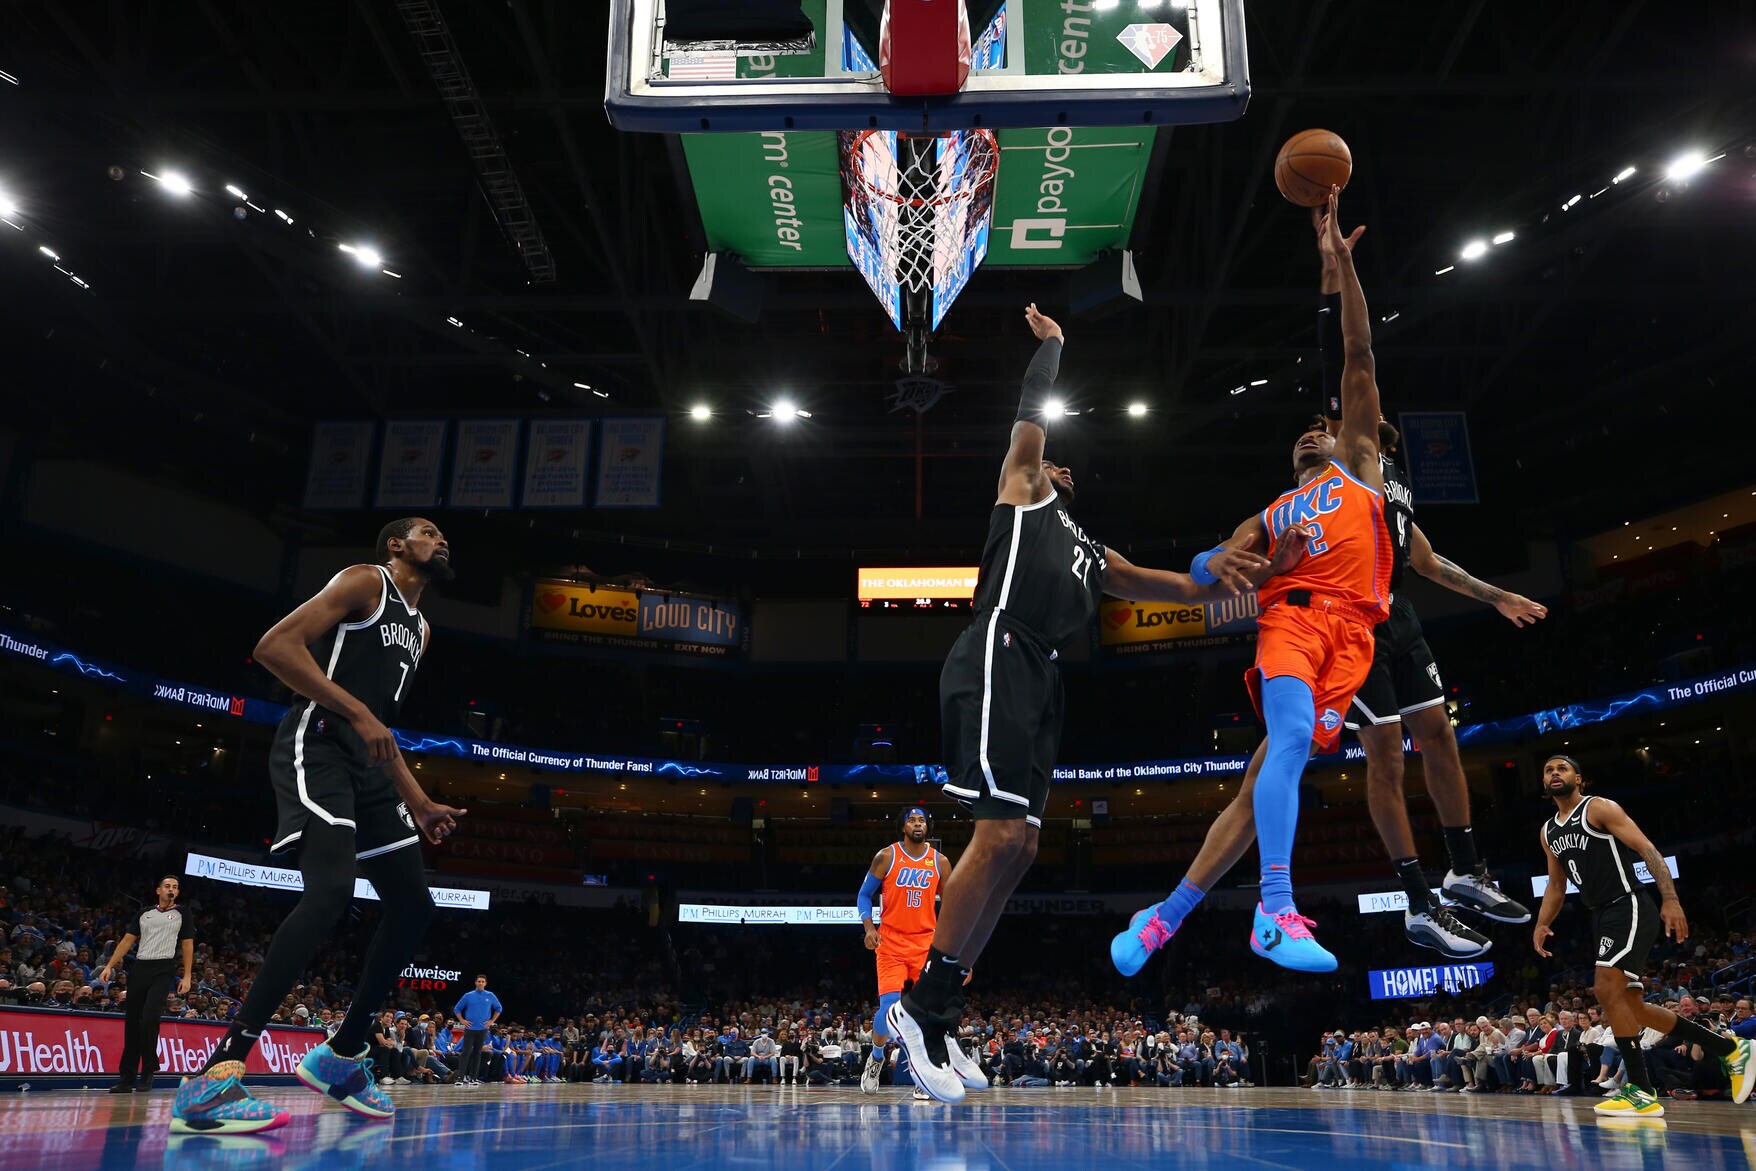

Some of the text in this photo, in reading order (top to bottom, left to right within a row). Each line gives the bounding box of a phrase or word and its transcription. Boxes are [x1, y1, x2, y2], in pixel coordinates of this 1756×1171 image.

[1155, 30, 1168, 43] 75
[768, 175, 804, 251] center
[1272, 476, 1344, 539] OKC
[1071, 545, 1092, 589] 21
[861, 579, 884, 588] THE
[886, 578, 962, 588] OKLAHOMAN
[643, 604, 691, 632] LOUD
[697, 605, 737, 638] CITY
[1209, 592, 1258, 629] LOUD
[0, 634, 49, 660] Thunder
[544, 631, 727, 655] BRING THE THUNDER EXIT NOW
[1116, 644, 1150, 654] BRING
[1152, 641, 1174, 651] THE
[1176, 637, 1229, 649] THUNDER
[394, 661, 409, 702] 7
[1668, 688, 1692, 701] The
[1694, 674, 1737, 695] Official
[472, 744, 653, 772] The Official Currency of Thunder Fans!
[1052, 760, 1245, 779] ficial Bank of the Oklahoma City Thunder
[197, 859, 215, 876] PM
[218, 862, 256, 879] PHILLIPS
[896, 867, 934, 889] OKC
[1568, 859, 1582, 885] 8
[431, 891, 476, 903] MURRAH
[906, 890, 922, 907] 15
[1371, 896, 1390, 910] PM
[682, 907, 854, 920] PM PHILLIPS MURRAH PM PHILLIPS
[397, 978, 447, 991] ZERO
[12, 1030, 105, 1073] Health
